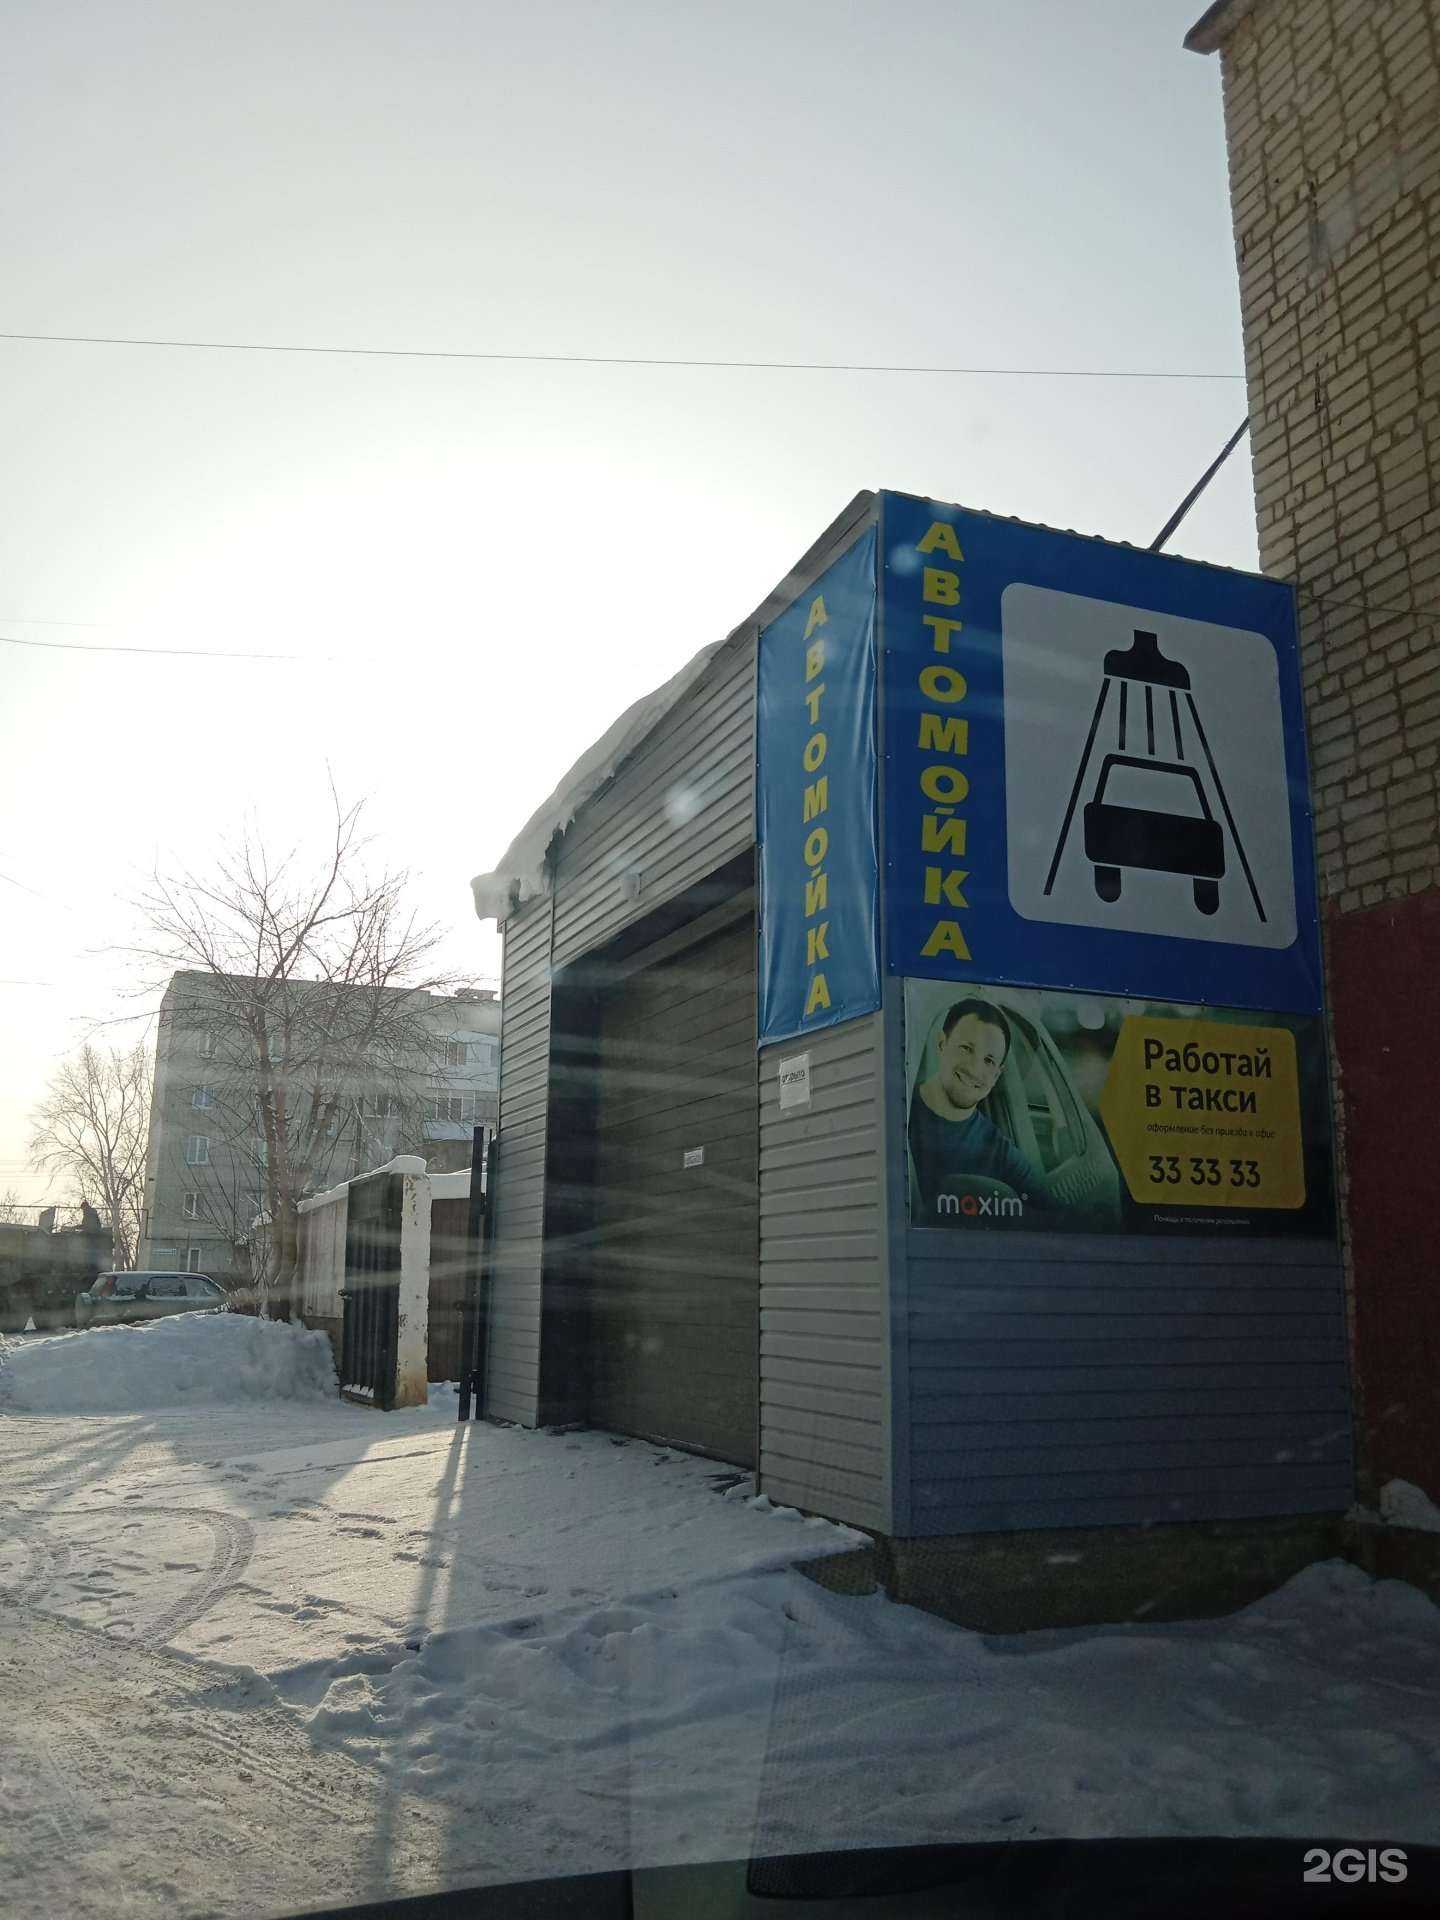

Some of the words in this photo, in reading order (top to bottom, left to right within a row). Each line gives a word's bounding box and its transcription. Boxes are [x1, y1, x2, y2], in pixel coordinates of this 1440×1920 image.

[915, 521, 972, 961] АВТОМОЙКА
[803, 594, 830, 1016] АВТОМОЙКА
[1144, 1038, 1272, 1078] Работай
[1145, 1085, 1161, 1107] в
[1170, 1086, 1257, 1114] такси
[1149, 1156, 1181, 1184] 33
[1190, 1158, 1221, 1186] 33
[1230, 1160, 1260, 1187] 33
[937, 1190, 1023, 1216] maxim
